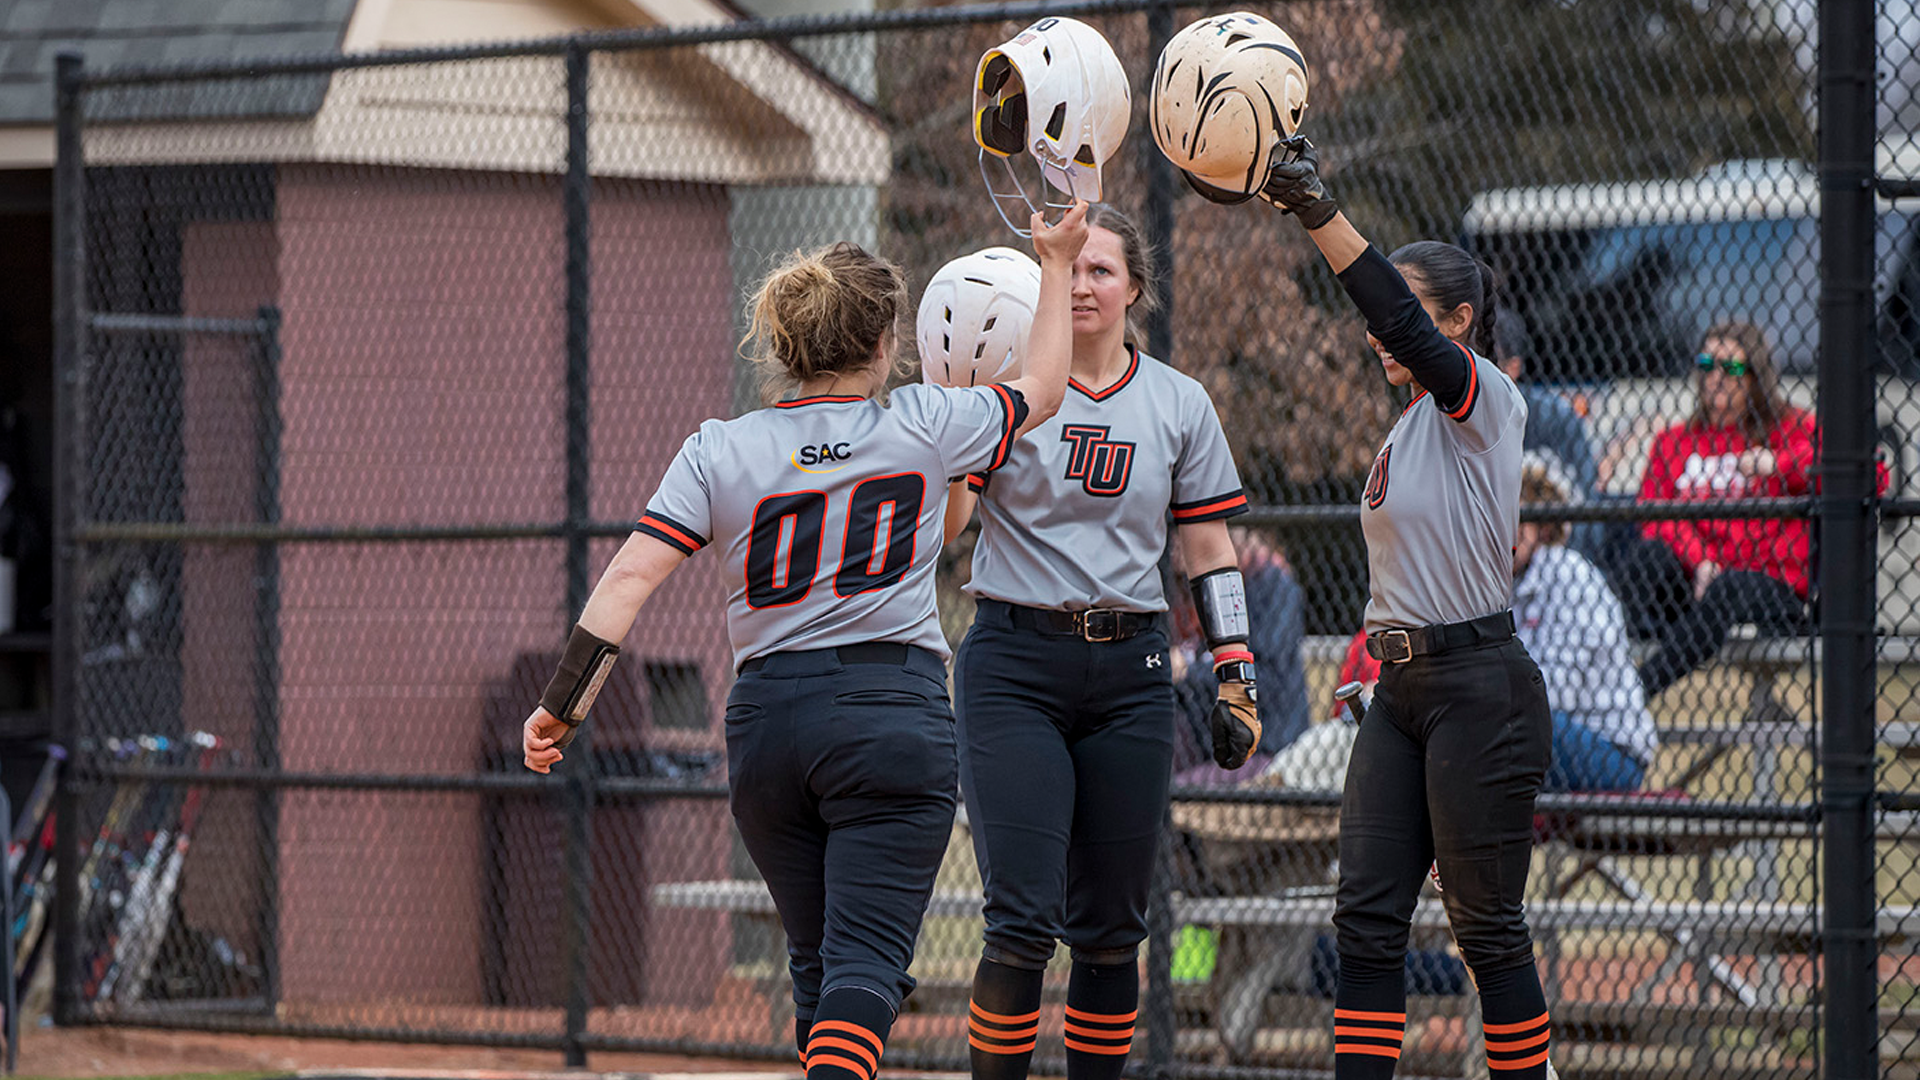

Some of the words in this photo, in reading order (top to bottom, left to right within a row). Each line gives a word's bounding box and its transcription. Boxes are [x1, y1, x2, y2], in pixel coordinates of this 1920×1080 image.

[800, 442, 852, 465] SAC
[1060, 423, 1137, 498] TU
[744, 470, 927, 611] 00
